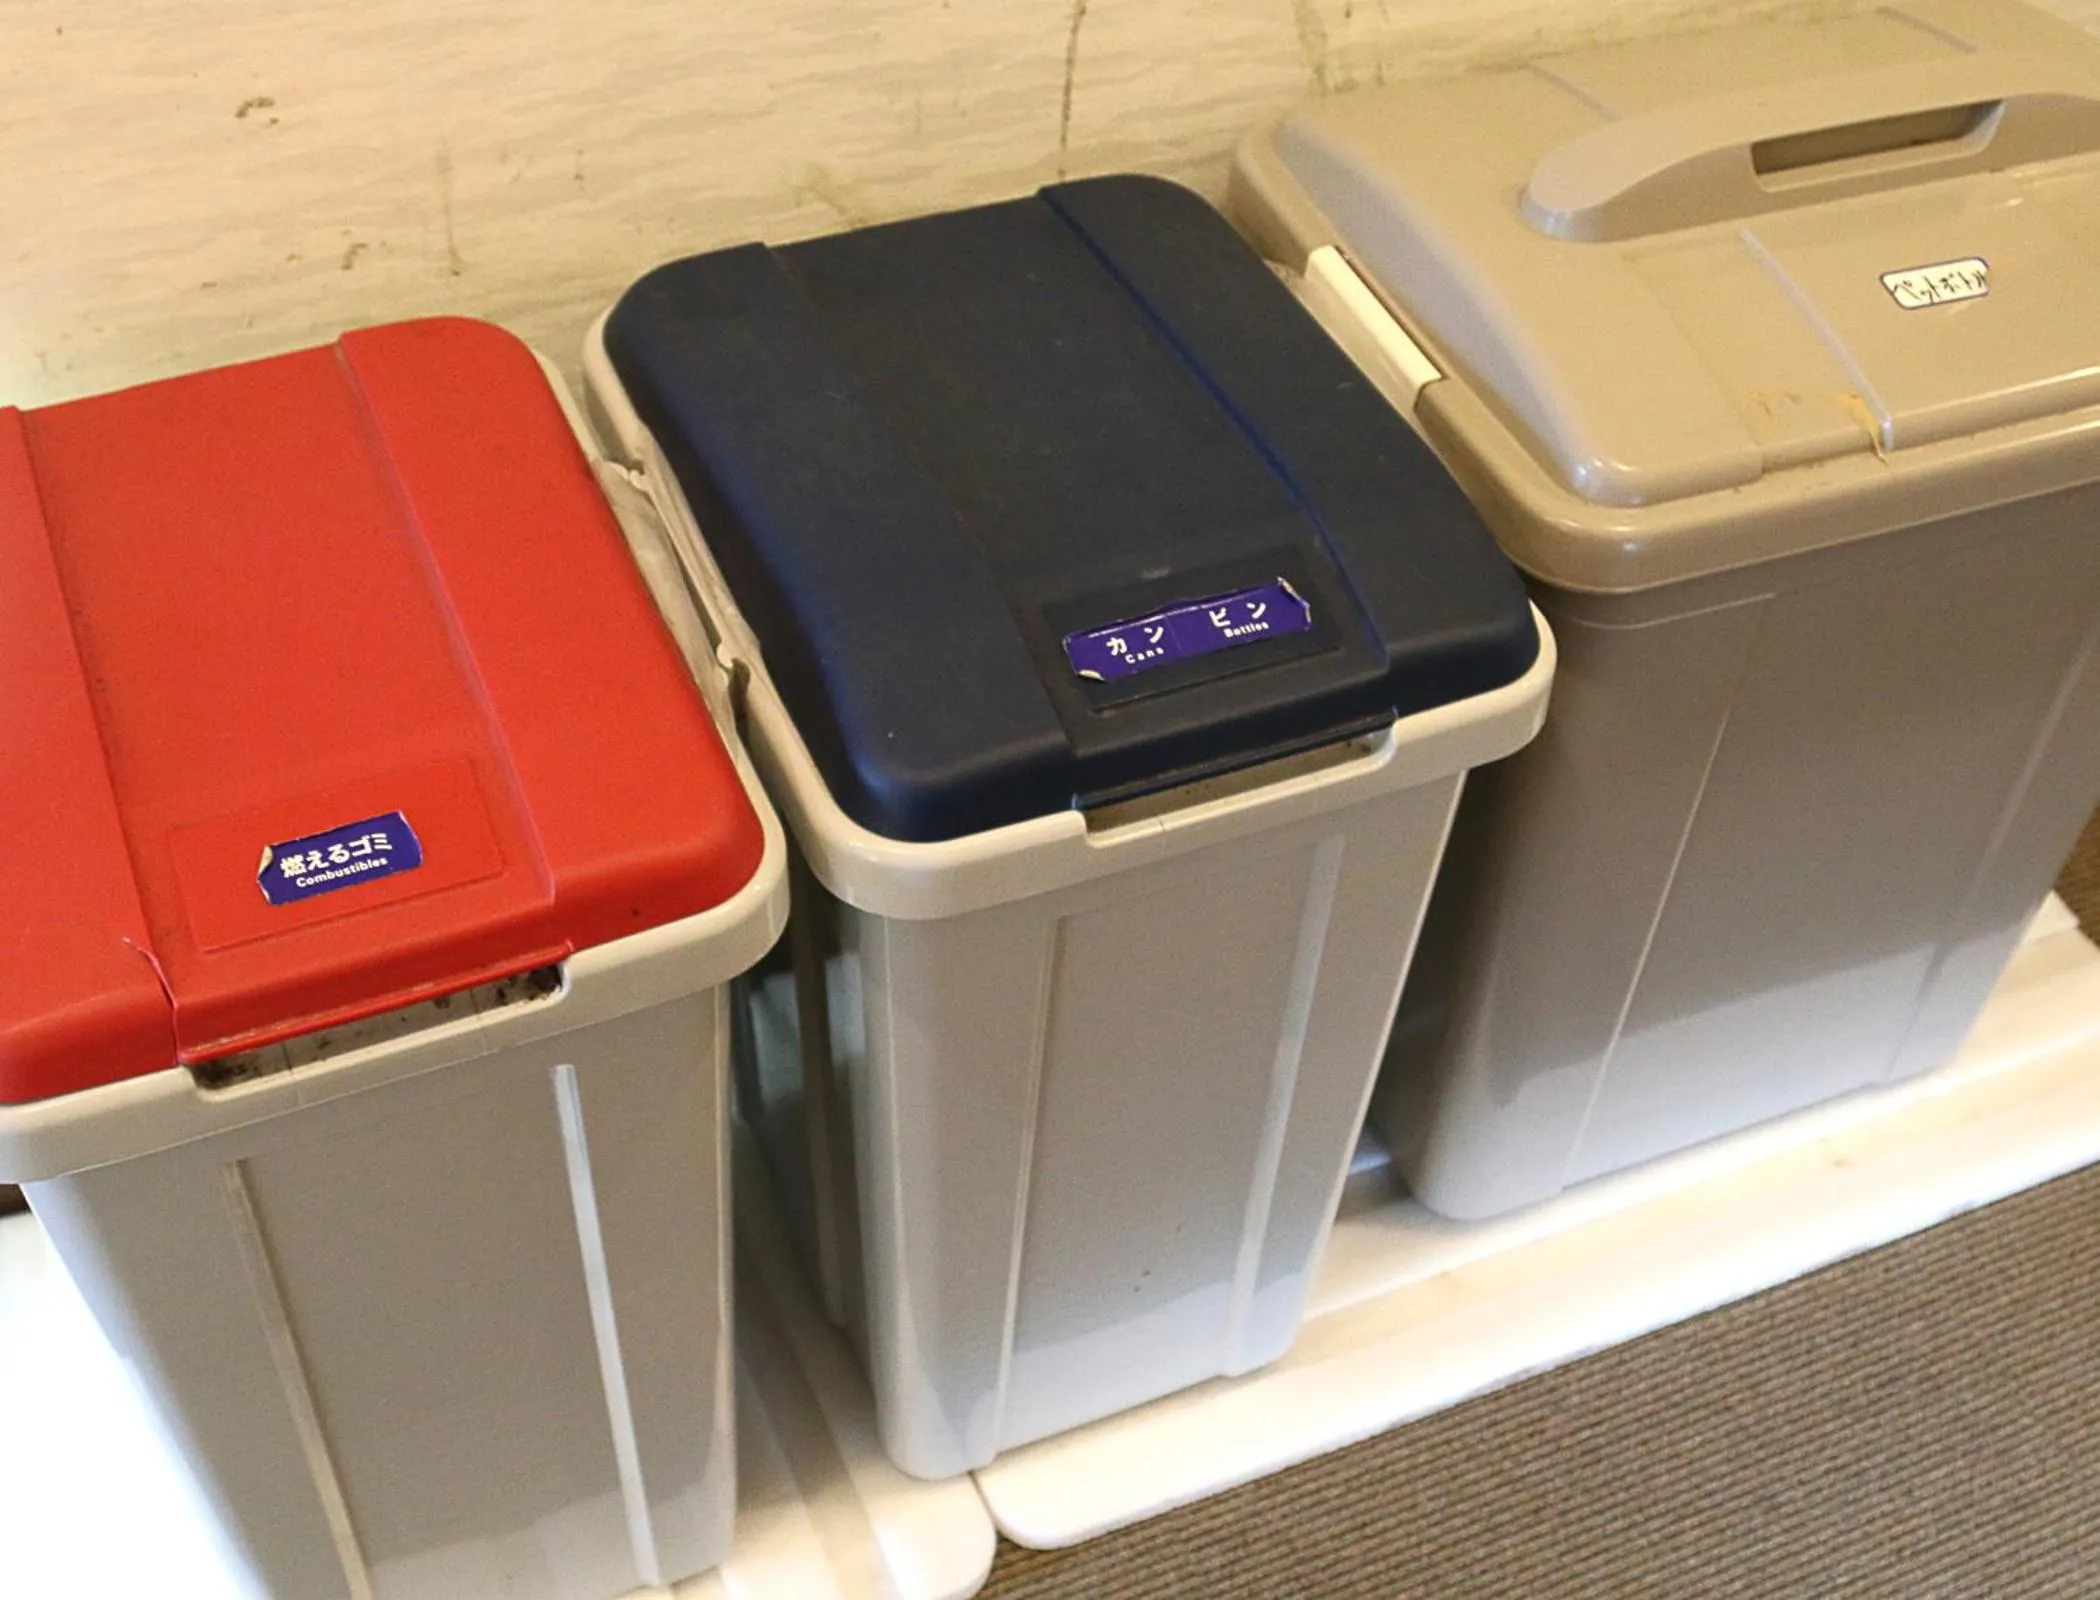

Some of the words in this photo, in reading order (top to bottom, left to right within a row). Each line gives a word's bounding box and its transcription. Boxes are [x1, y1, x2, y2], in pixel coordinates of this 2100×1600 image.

[1106, 626, 1164, 656] カン
[1208, 602, 1267, 628] ビン
[1125, 646, 1165, 664] Cans
[1223, 620, 1270, 639] Bottles
[279, 832, 393, 879] 燃えるゴミ
[295, 857, 389, 888] Combustibles
